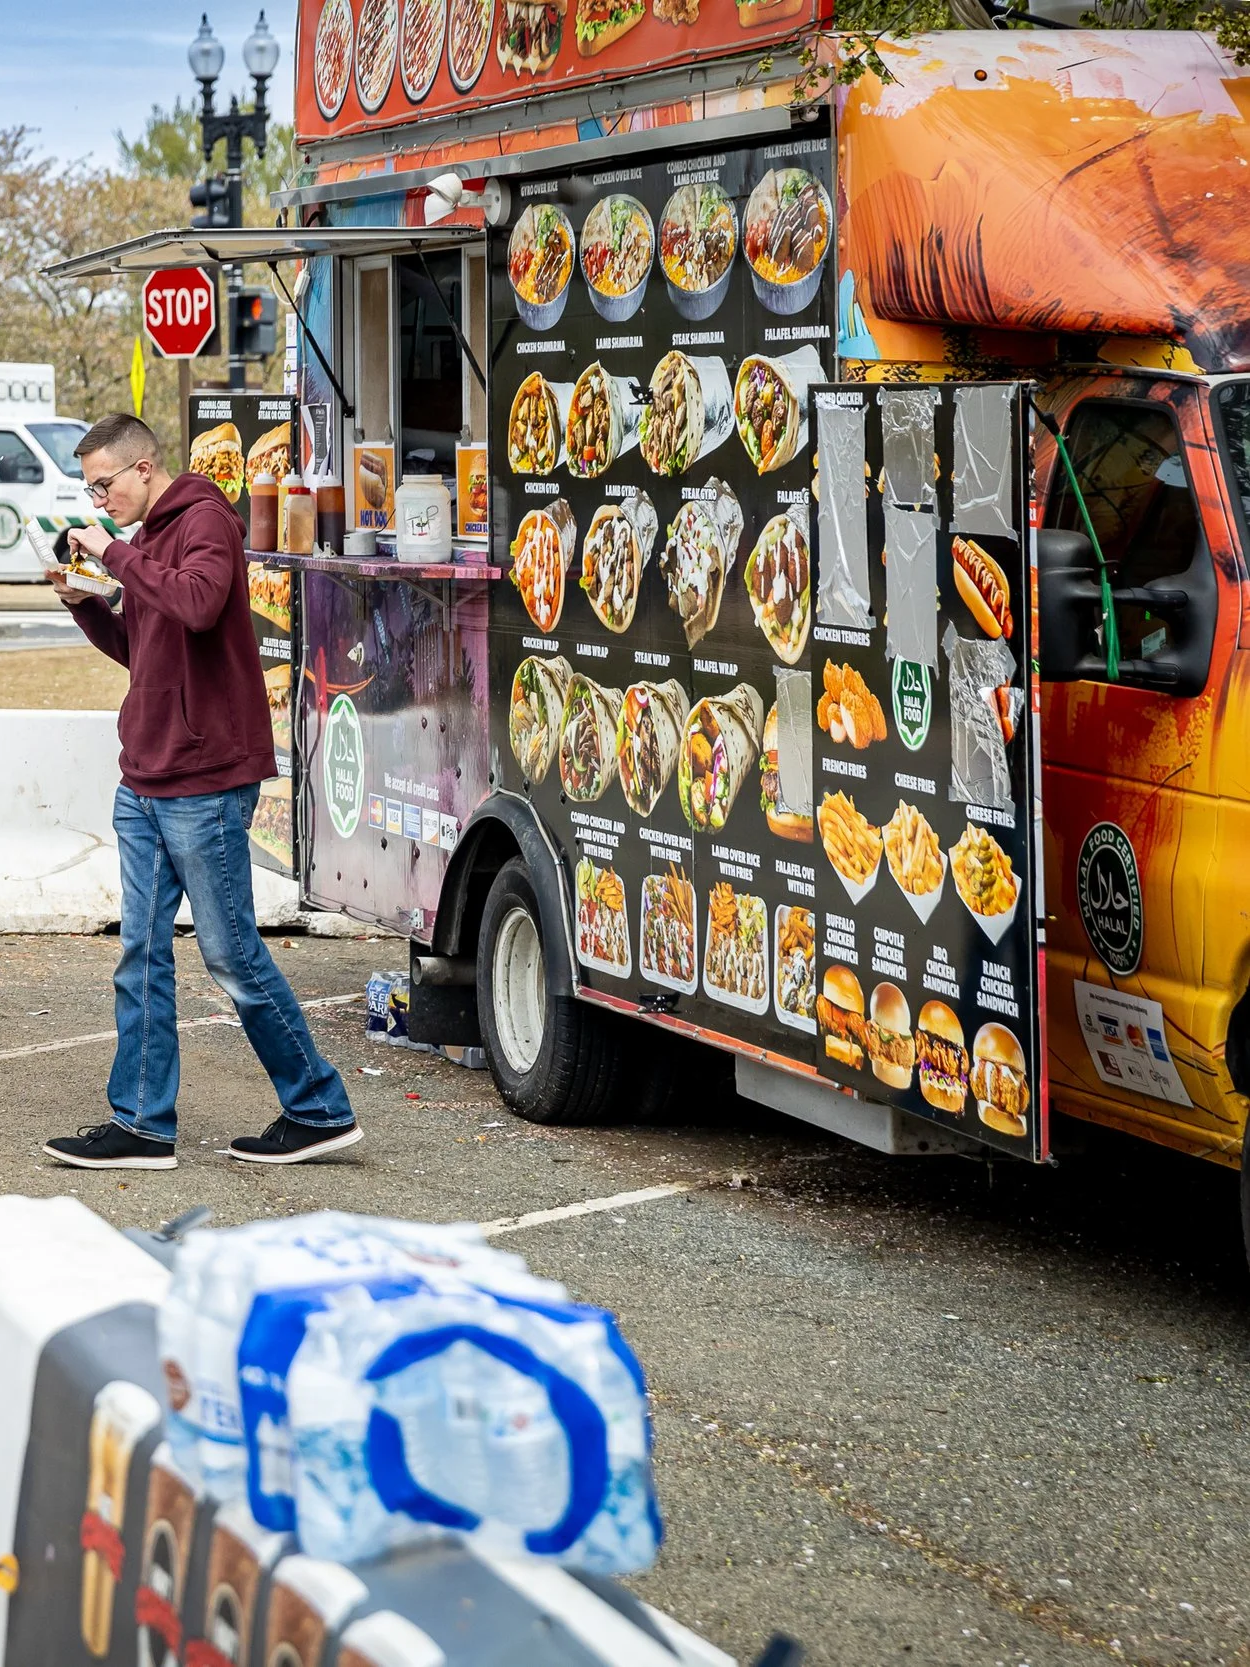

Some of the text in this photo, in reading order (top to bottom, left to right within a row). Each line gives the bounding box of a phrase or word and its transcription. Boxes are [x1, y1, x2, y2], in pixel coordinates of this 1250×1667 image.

[764, 138, 827, 159] FALAFFEL OVER RICE
[667, 154, 726, 174] COMBO CHICKEN AND
[593, 168, 642, 186] CHICKEN OVER RICE
[674, 169, 719, 186] LAMB OVER RICE
[520, 180, 558, 197] GYRO OVER RICE
[148, 287, 208, 326] STOP
[596, 336, 643, 350] LAMB SHAWARMA
[672, 331, 724, 346] STEAK SHAWARMA
[764, 325, 830, 342] FALAFEL SHAWARMA
[516, 340, 565, 354] CHICKEN SHAWARMA
[279, 401, 290, 410] CHEES
[837, 392, 863, 406] CHICKEN
[525, 482, 559, 495] CHICKEN GYRO
[606, 484, 636, 498] LAMB GYRO
[682, 487, 717, 501] STEAK GYRO
[777, 490, 803, 504] FALAFEL
[360, 510, 388, 527] HOT DOG
[465, 522, 482, 532] CHICKEN
[522, 636, 559, 652] CHICKEN WRAP
[814, 627, 870, 646] CHICKEN TENDERS
[576, 643, 608, 659] LAMB WRAP
[634, 650, 670, 667] STEAK WRAP
[694, 658, 738, 676] FALAFEL WRAP
[904, 694, 922, 708] HALAL
[904, 706, 922, 722] FOOD
[336, 767, 354, 786] HALAL
[822, 758, 866, 780] FRENCH FRIES
[336, 782, 354, 802] FOOD
[384, 772, 392, 788] We
[392, 777, 406, 795] accept
[413, 782, 426, 798] credit
[426, 786, 439, 802] cards
[894, 772, 936, 795] CHEESE FRIES
[570, 811, 625, 834] COMBO CHICKEN AND
[966, 804, 992, 824] CHEESE
[578, 828, 618, 848] LAMB OVER RICE
[639, 827, 692, 850] CHICKEN OVER RICE
[584, 844, 612, 860] WITH FRIES
[650, 844, 681, 864] WITH FRIES
[712, 844, 760, 868] LAMB OVER RICE
[719, 862, 753, 882] WITH FRIES
[776, 860, 814, 882] FALAFEL OVE
[1088, 830, 1114, 852] FOOD
[1116, 837, 1140, 931] CERTIFIED
[788, 878, 814, 898] WITH FRI
[826, 912, 855, 934] BUFFALO
[1098, 914, 1128, 936] HALAL
[827, 928, 855, 949] CHICKEN
[874, 926, 904, 949] CHIPOTLE
[824, 942, 858, 966] SANDWICH
[876, 942, 904, 964] CHICKEN
[933, 945, 948, 962] BBQ
[1108, 950, 1130, 968] 100%
[872, 957, 907, 982] SANDWICH
[926, 960, 956, 982] CHICKEN
[982, 960, 1011, 982] RANCH
[922, 974, 960, 1000] SANDWICH
[980, 976, 1014, 1000] CHICKEN
[976, 994, 1019, 1019] SANDWICH
[1104, 1024, 1118, 1038] VISA
